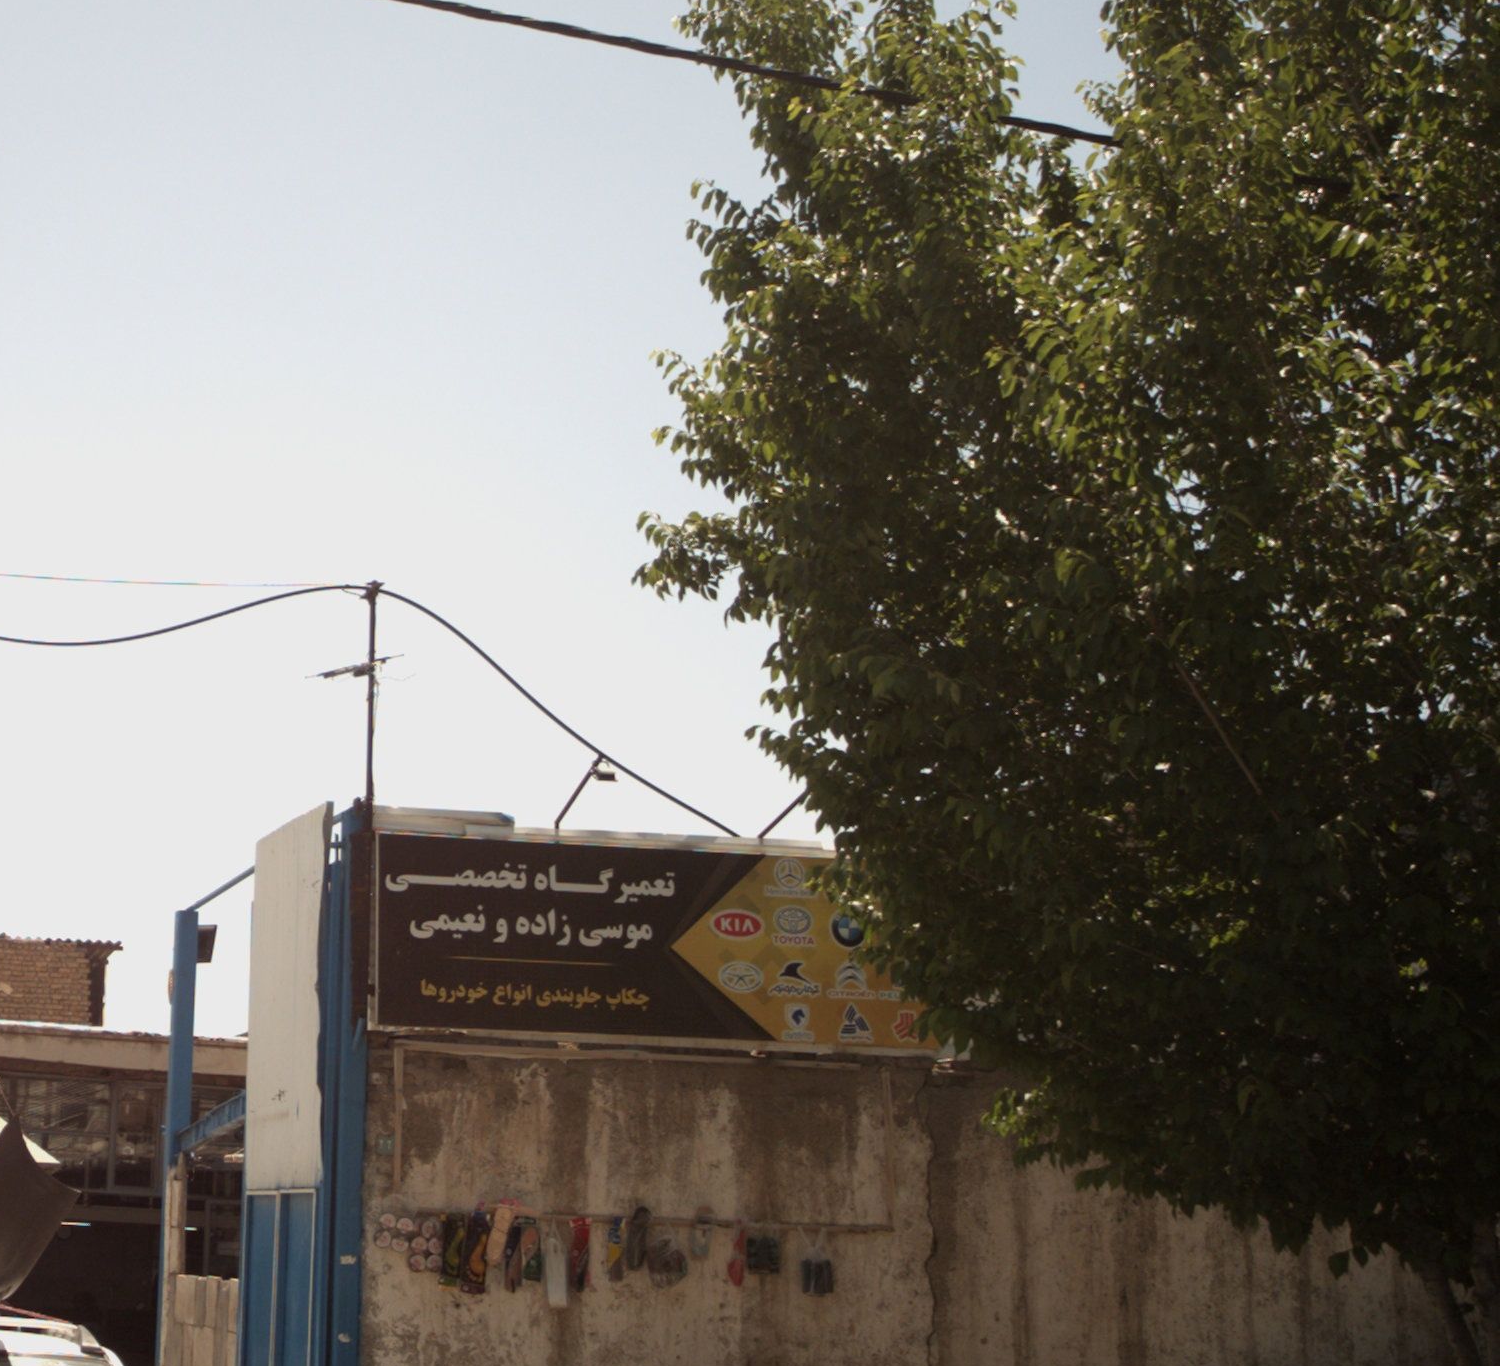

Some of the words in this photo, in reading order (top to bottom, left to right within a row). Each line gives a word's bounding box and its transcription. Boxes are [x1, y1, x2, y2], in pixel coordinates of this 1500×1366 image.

[384, 862, 528, 893] تخصصی
[409, 904, 486, 940] نعیمی
[493, 916, 509, 943] و
[515, 908, 572, 947] زاده
[578, 920, 653, 949] موسی
[719, 917, 756, 933] KIA
[773, 935, 815, 946] TOYOTA
[419, 978, 488, 1004] خودروها
[492, 982, 532, 1006] انواع
[535, 985, 601, 1009] جلوبندی
[605, 988, 650, 1012] چکاپ
